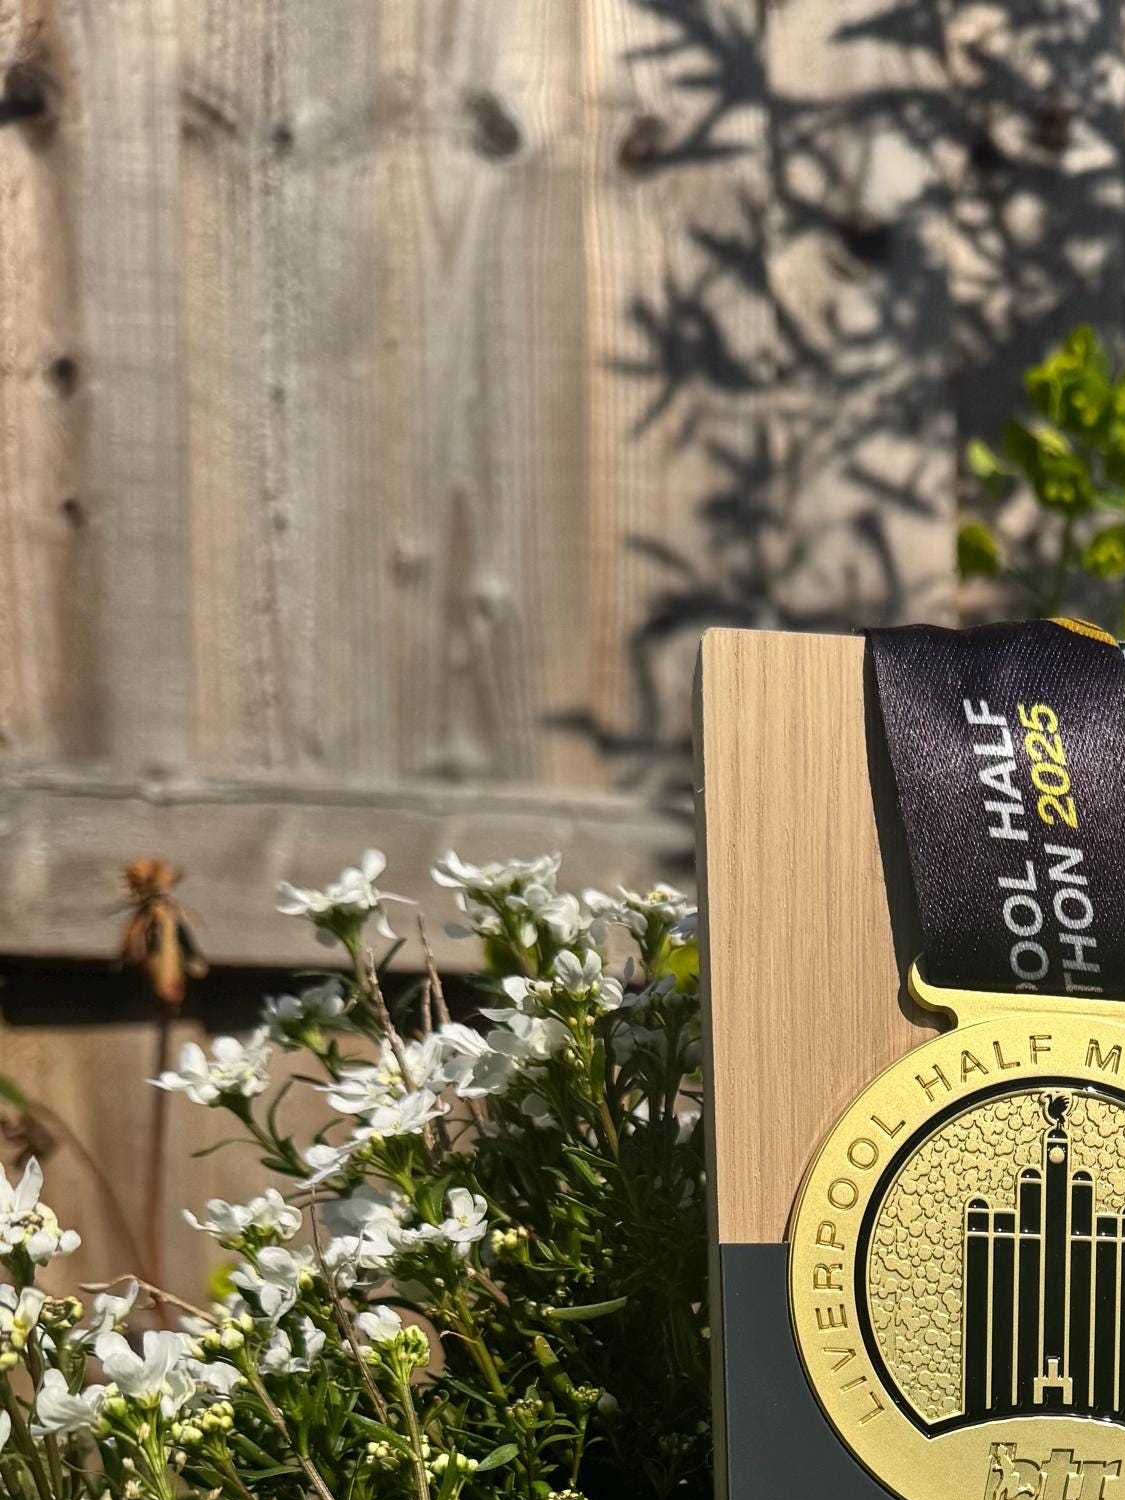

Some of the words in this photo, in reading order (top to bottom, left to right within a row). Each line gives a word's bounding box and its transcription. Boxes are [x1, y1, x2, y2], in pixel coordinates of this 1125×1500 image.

[963, 698, 1029, 842] HALF
[1018, 703, 1079, 829] 2025
[999, 860, 1050, 992] OOL
[812, 1113, 906, 1427] LIVERPOOL
[914, 1034, 1053, 1102] HALF
